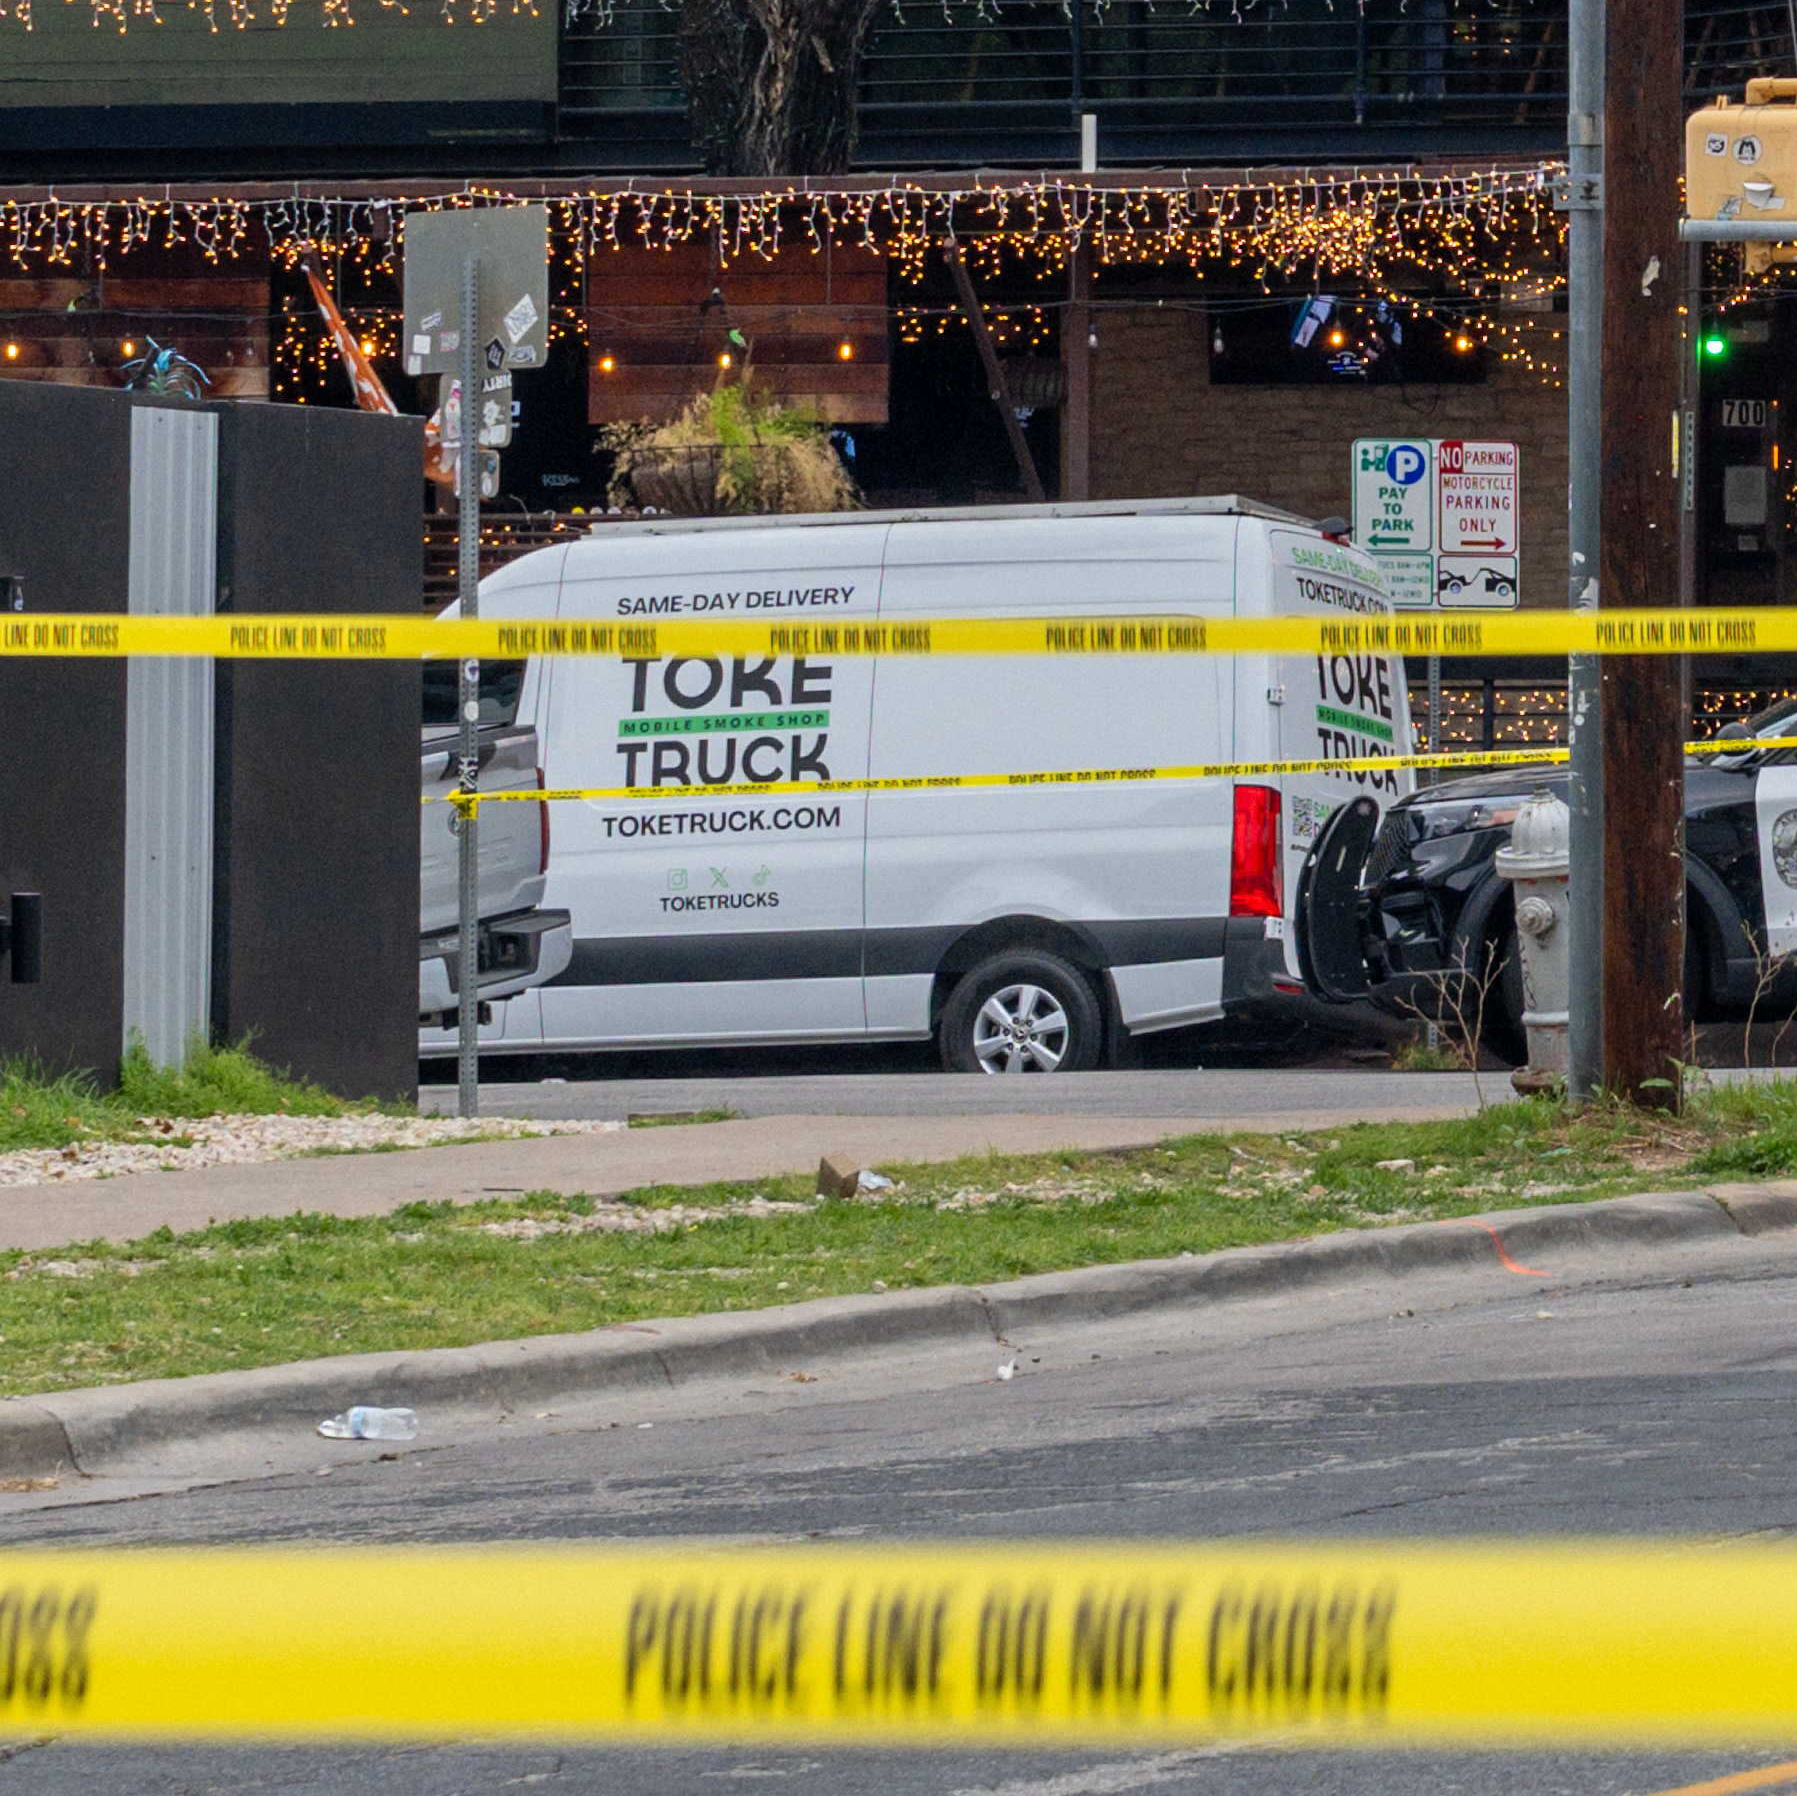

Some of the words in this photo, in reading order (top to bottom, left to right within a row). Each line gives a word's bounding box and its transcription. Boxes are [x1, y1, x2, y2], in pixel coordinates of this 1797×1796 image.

[1725, 401, 1764, 425] 700
[1396, 450, 1419, 481] P
[1441, 447, 1462, 469] NO
[1465, 451, 1513, 466] PARKING
[1379, 487, 1408, 499] PAY
[1443, 476, 1513, 490] MOTORCYCLE
[1383, 503, 1403, 515] TO
[1446, 495, 1510, 510] PARKING
[1371, 518, 1414, 531] PARK
[1459, 517, 1497, 532] ONLY
[617, 593, 741, 615] SAME-DAY
[745, 586, 855, 609] DELIVERY
[622, 652, 833, 712] TOKE
[1318, 654, 1393, 720] TOKE
[623, 719, 693, 734] MOBILE
[703, 715, 766, 730] SMOKE
[776, 713, 825, 727] SHOP
[617, 733, 831, 789] TRUCK
[1317, 728, 1398, 796] TRUCK
[602, 806, 841, 838] TOKETRUCK.COM
[660, 892, 780, 912] TOKETRUCKS
